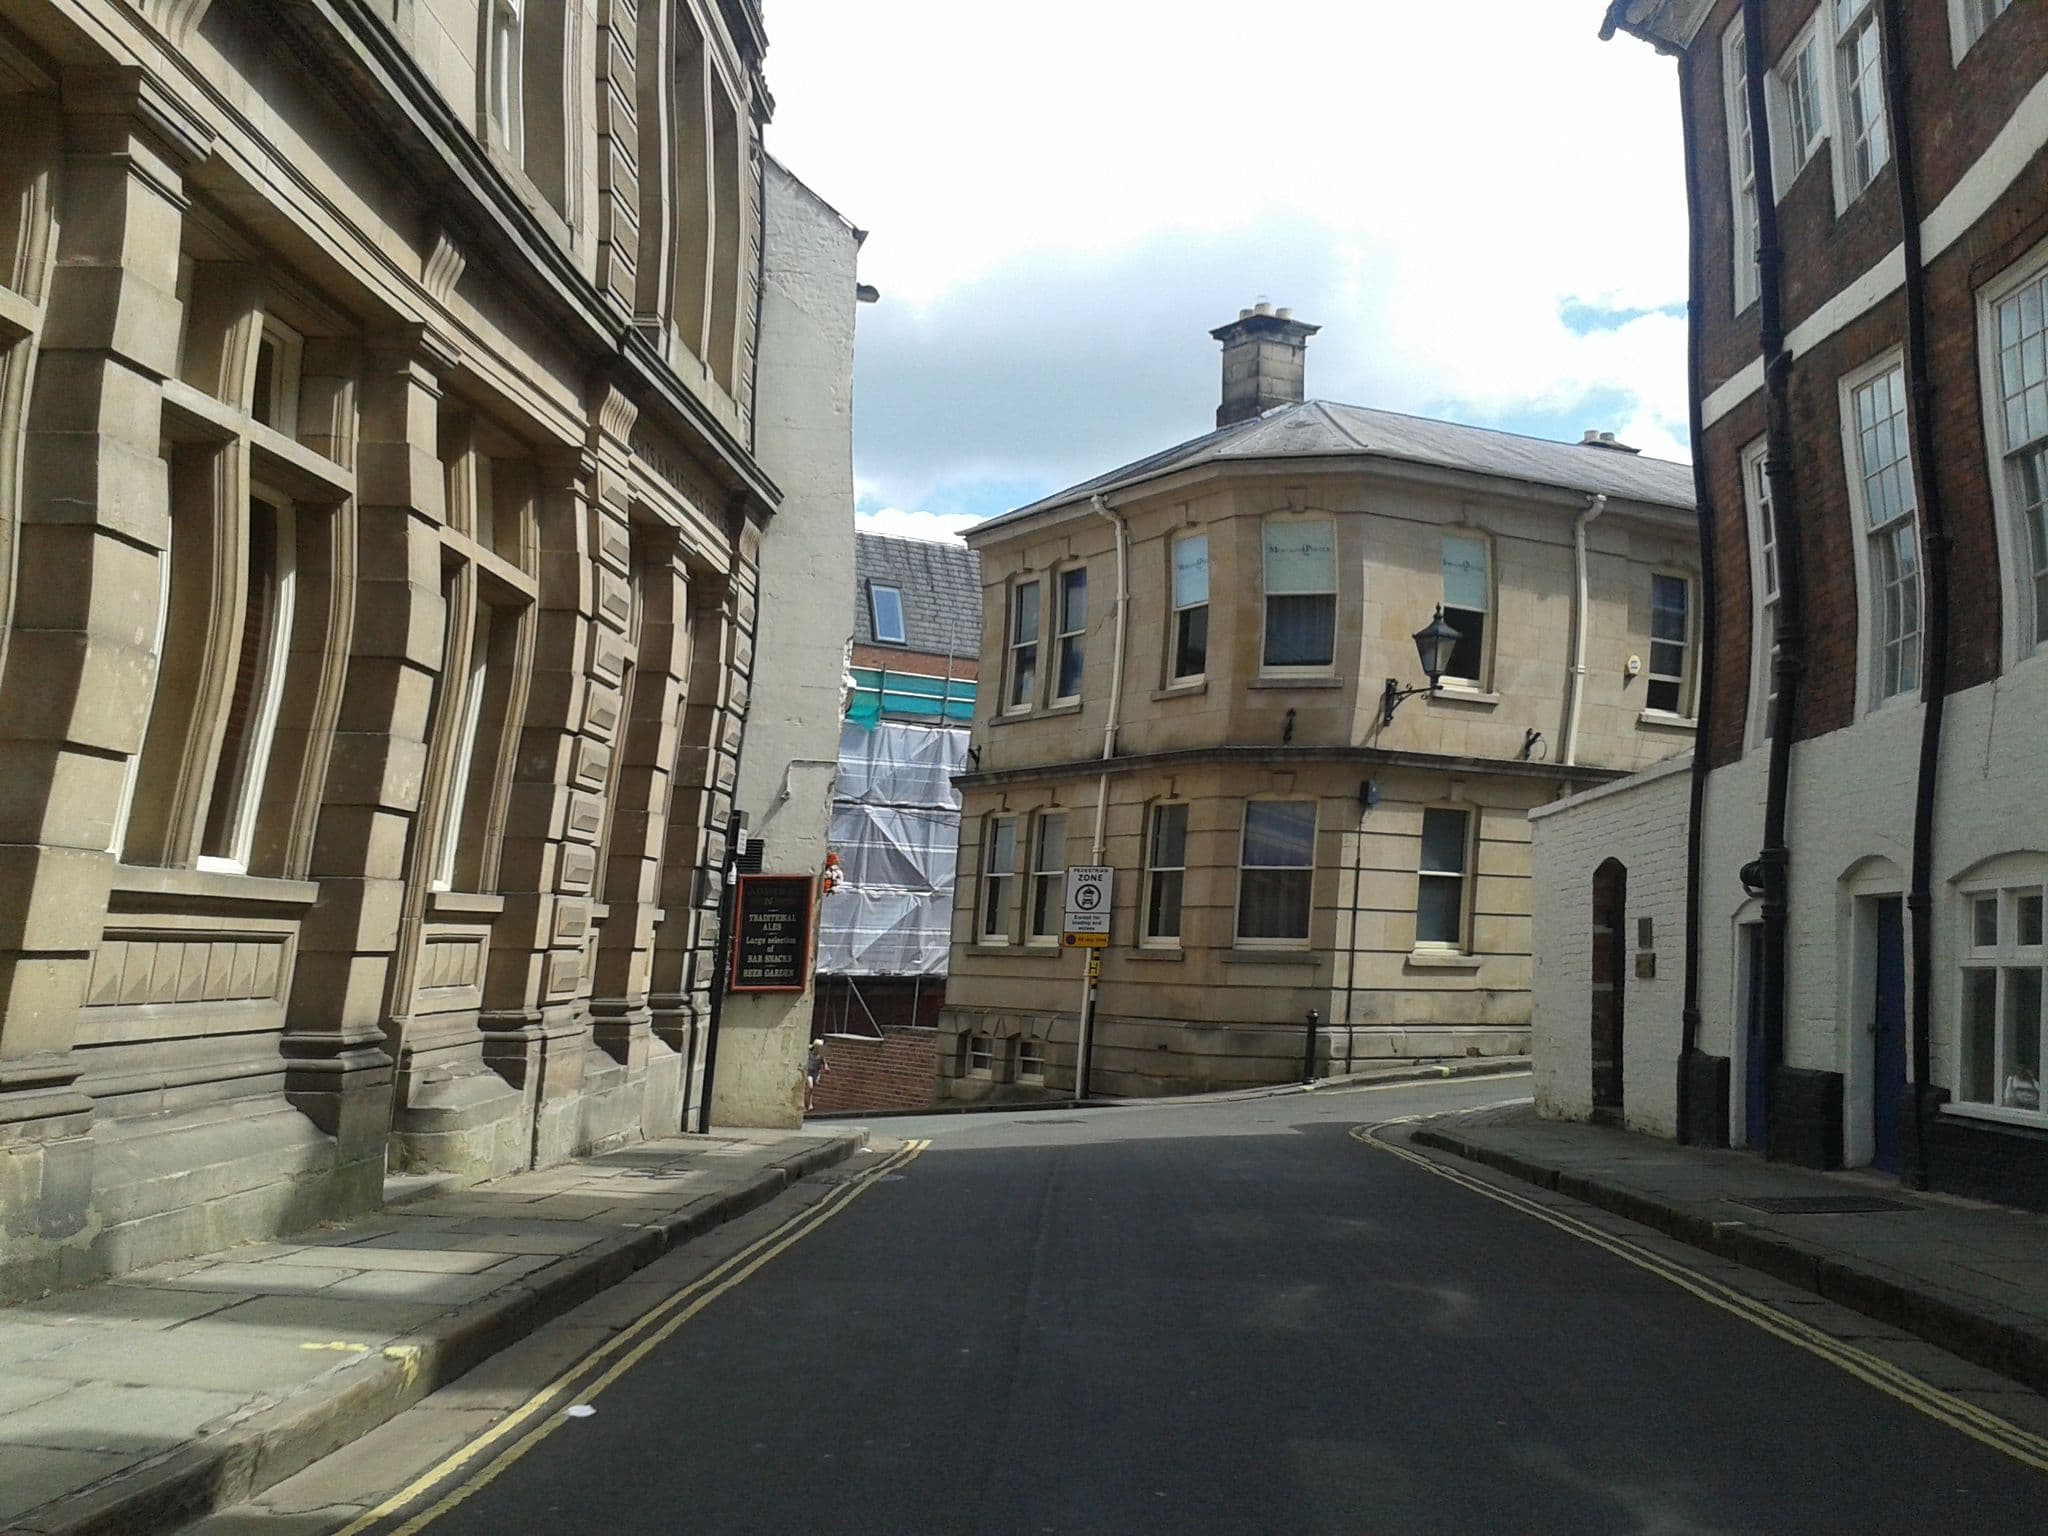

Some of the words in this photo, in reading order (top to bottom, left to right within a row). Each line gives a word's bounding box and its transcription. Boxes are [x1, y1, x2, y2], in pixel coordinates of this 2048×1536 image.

[1078, 874, 1103, 882] ZONE
[749, 913, 796, 922] TRADITIONAL
[762, 923, 782, 931] ALES
[746, 936, 766, 945] Large
[767, 945, 775, 953] of
[747, 955, 763, 963] BAR
[764, 955, 792, 963] SNACKS
[1089, 961, 1098, 975] H
[743, 969, 762, 978] BEER
[764, 969, 795, 977] GARDEN
